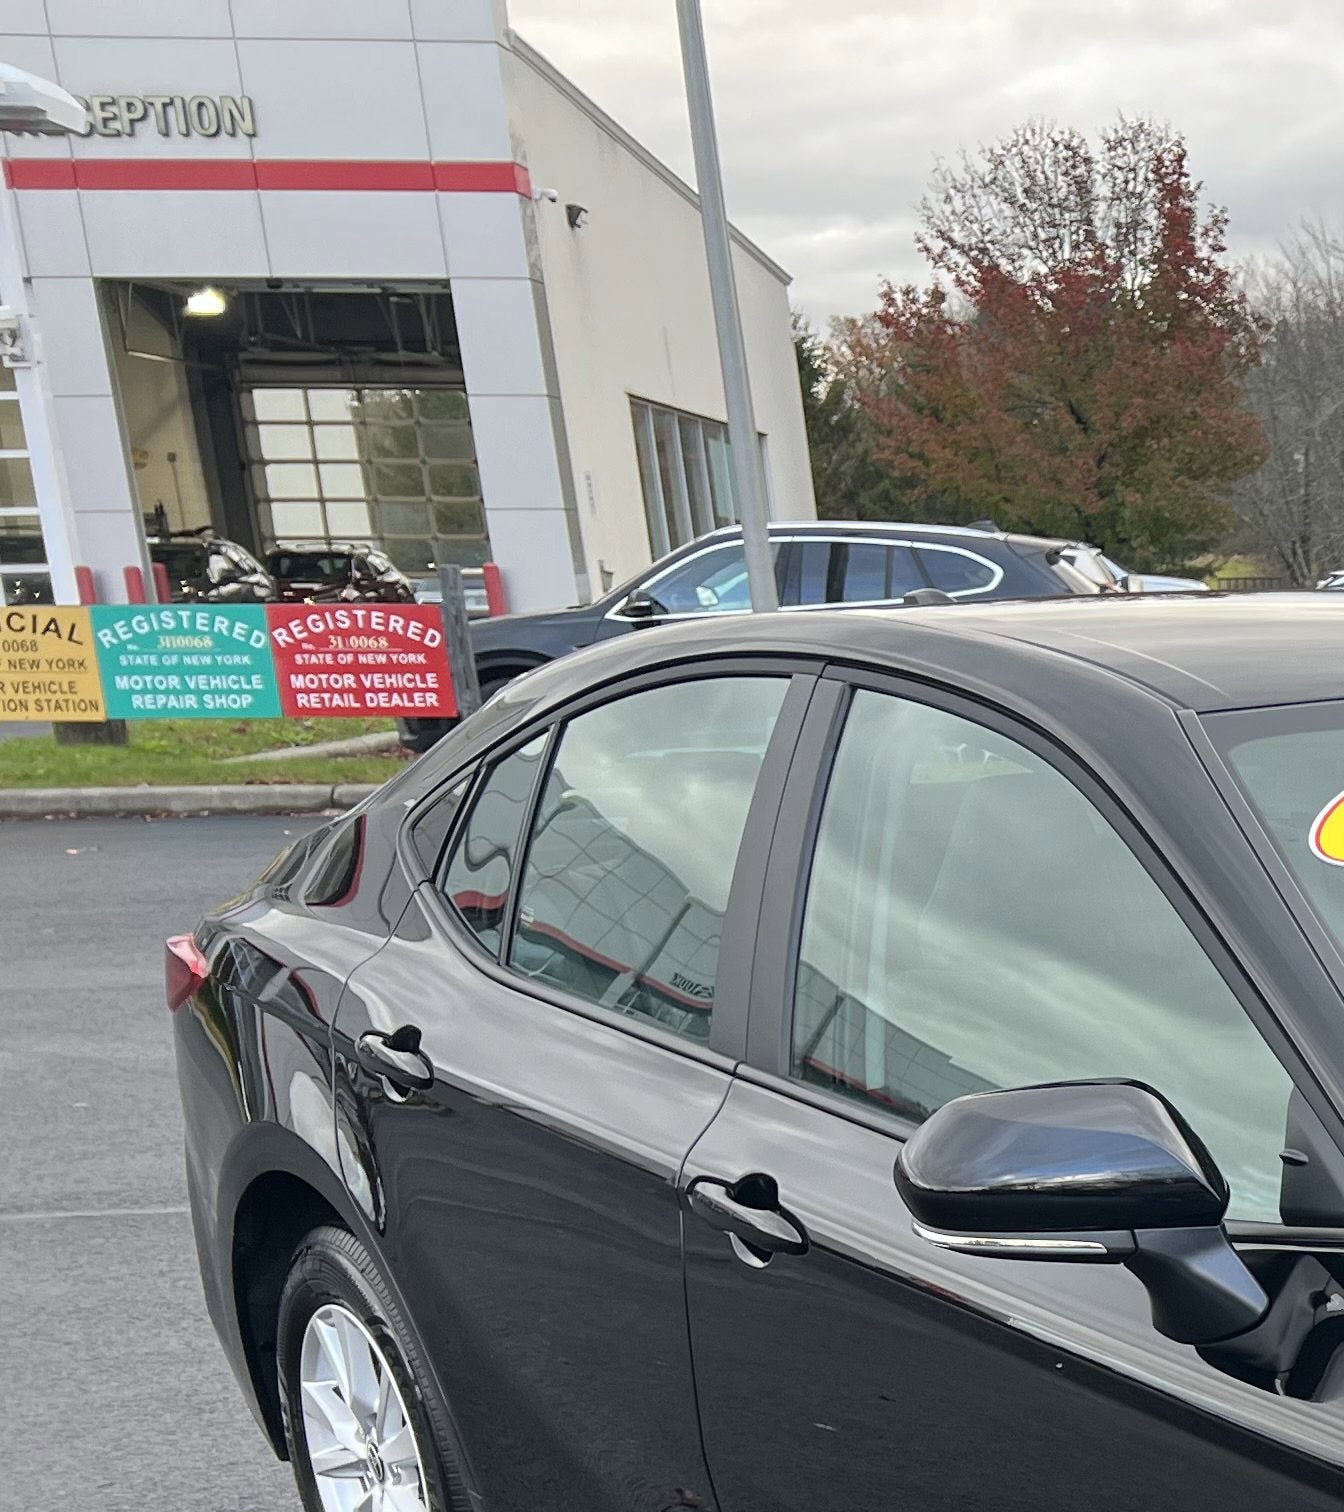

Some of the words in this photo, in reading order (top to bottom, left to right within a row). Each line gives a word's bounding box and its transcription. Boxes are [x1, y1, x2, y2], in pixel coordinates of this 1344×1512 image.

[97, 610, 267, 649] REGISTERED
[271, 609, 442, 648] REGISTERED
[8, 658, 41, 671] NEW
[45, 658, 88, 671] YORK
[119, 654, 159, 666] STATE
[162, 655, 179, 665] OF
[183, 654, 213, 665] NEW
[215, 654, 251, 665] YORK
[295, 653, 335, 665] STATE
[337, 654, 354, 665] OF
[358, 654, 388, 664] NEW
[391, 653, 427, 665] YORK
[10, 680, 78, 695] VEHICLE
[114, 674, 181, 690] MOTOR
[184, 674, 264, 690] VEHICLE
[290, 673, 358, 690] MOTOR
[359, 672, 440, 689] VEHICLE
[34, 698, 100, 713] STATION
[131, 693, 199, 710] REPAIR
[202, 693, 254, 709] SHOP
[296, 692, 361, 709] RETAIL
[365, 692, 440, 708] DEALER
